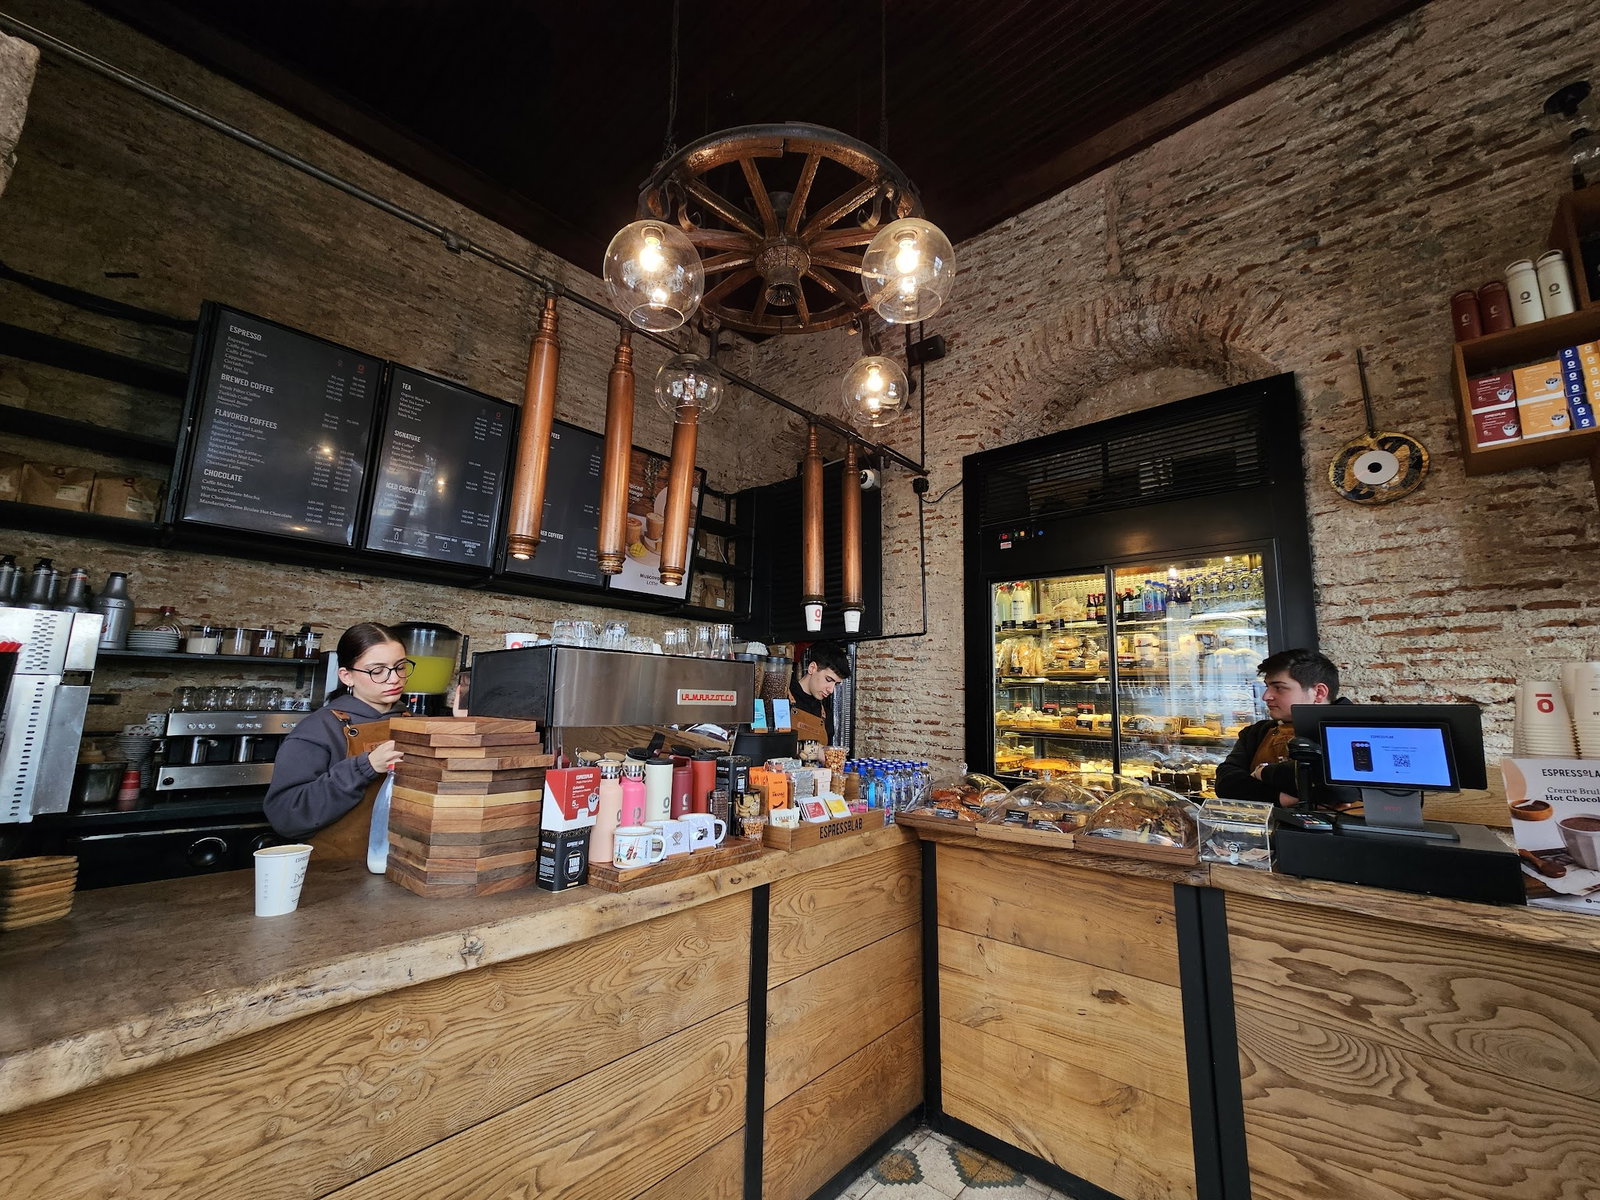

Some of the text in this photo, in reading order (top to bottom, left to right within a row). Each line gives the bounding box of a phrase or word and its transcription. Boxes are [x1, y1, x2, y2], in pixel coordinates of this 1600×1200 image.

[229, 325, 262, 341] ESPRESSO
[220, 373, 274, 393] BREWED COFFEE
[401, 382, 411, 391] TEA
[214, 408, 278, 429] FLAVORED COFFEES
[393, 429, 421, 442] SIGNATURE
[203, 468, 242, 482] CHOCOLATE
[385, 482, 426, 496] ICED CHOCOLATE
[1546, 786, 1578, 795] Creme
[1545, 794, 1564, 802] Hot
[819, 817, 863, 839] ESPRESSOLAB
